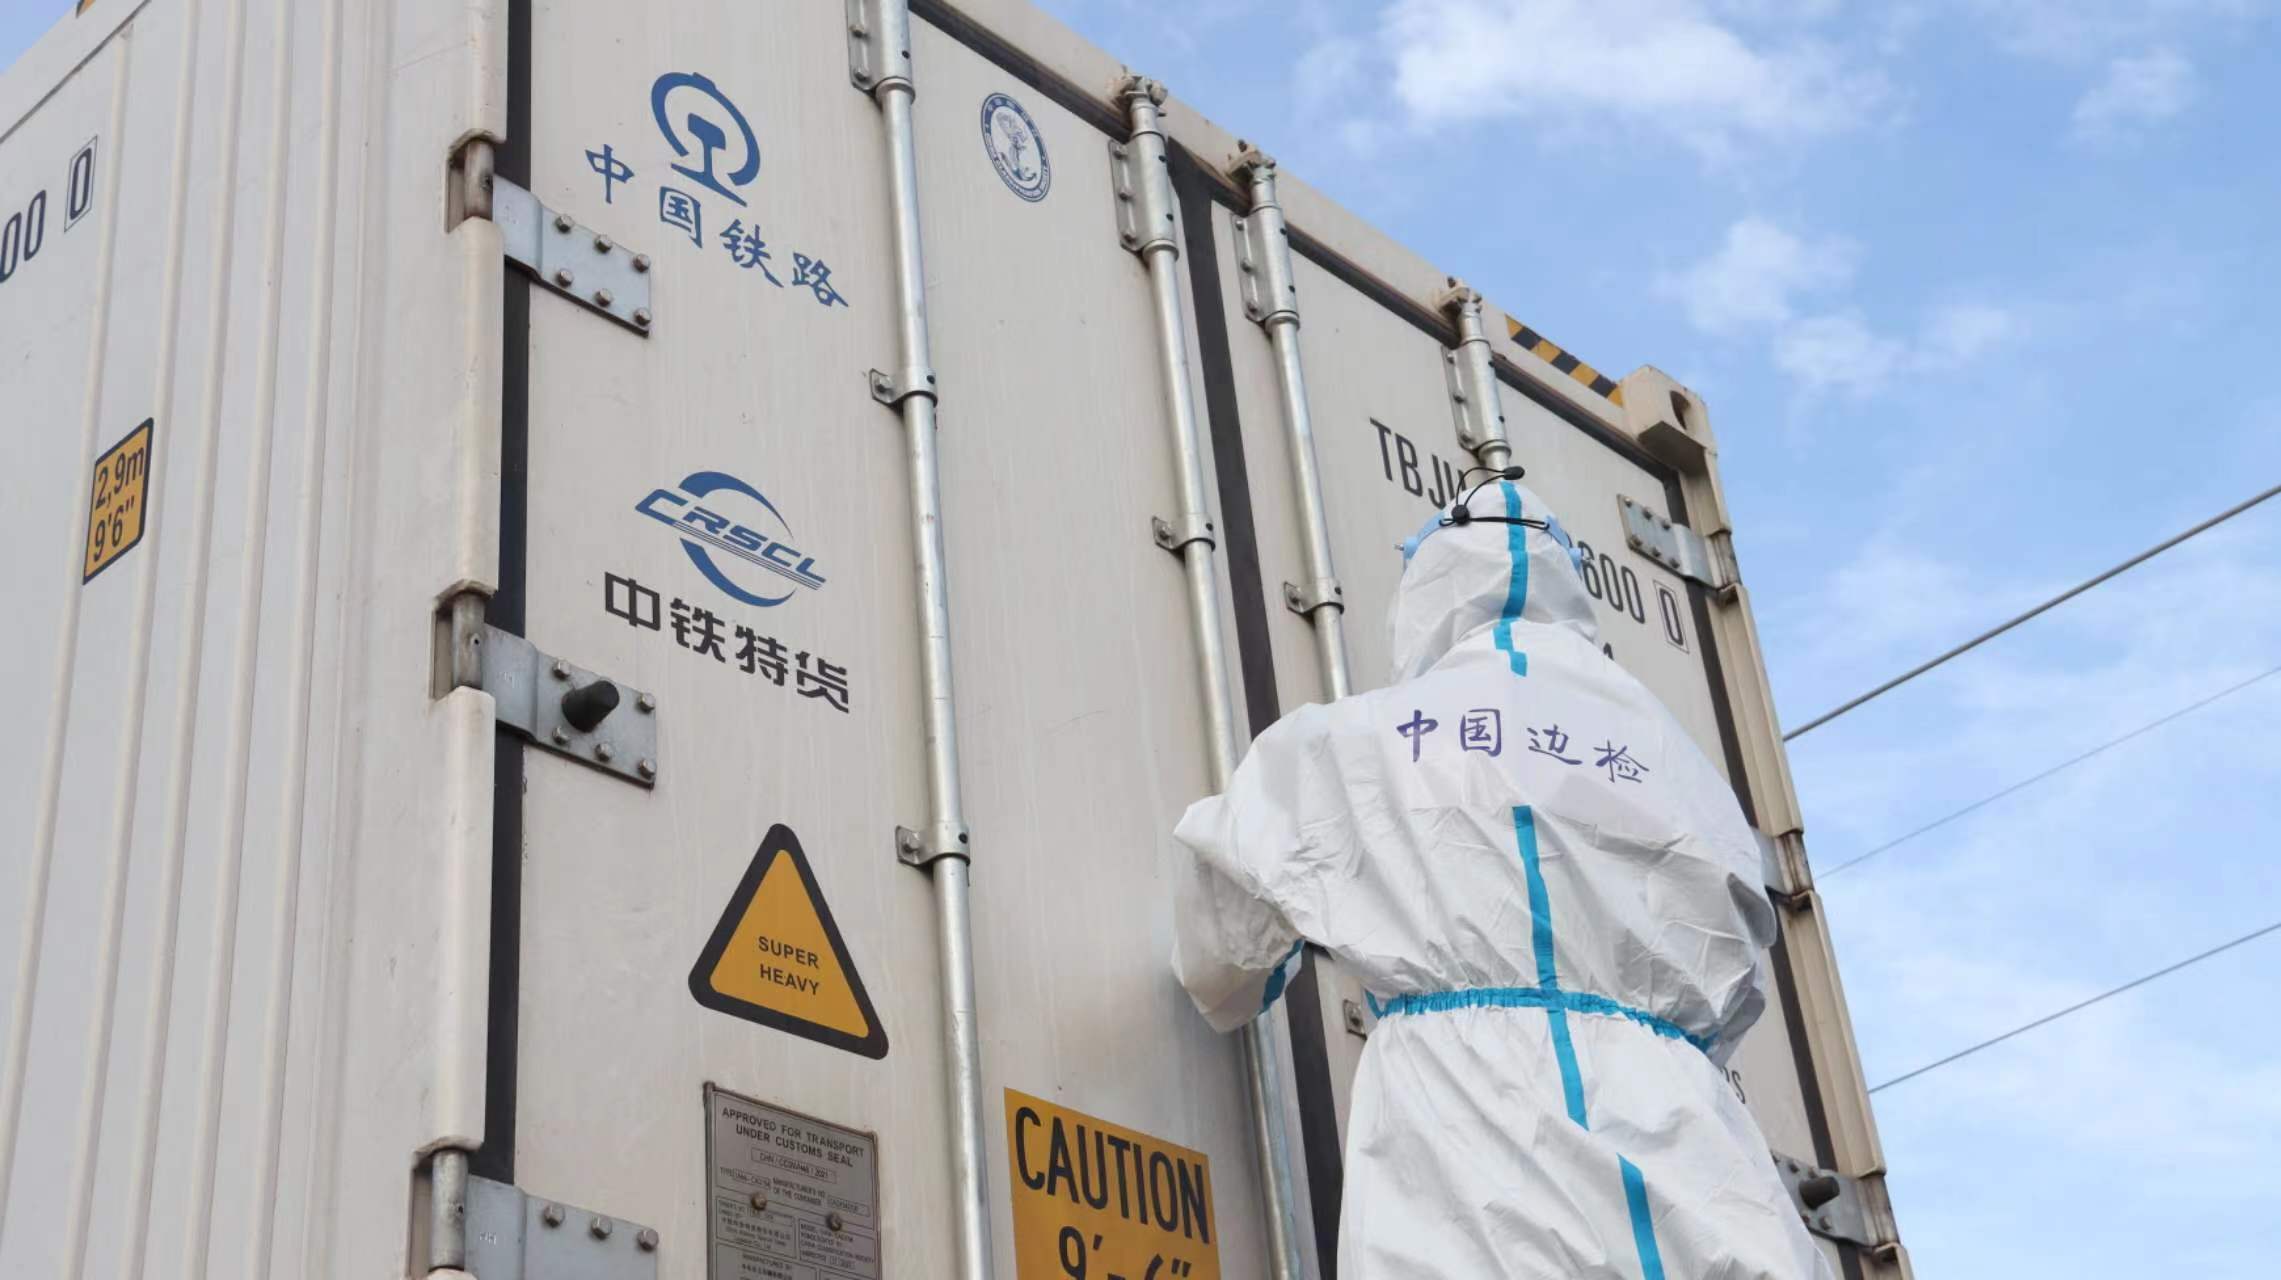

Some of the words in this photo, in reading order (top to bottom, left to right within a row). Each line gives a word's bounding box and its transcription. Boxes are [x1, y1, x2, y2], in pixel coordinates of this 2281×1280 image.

[69, 147, 92, 221] 0
[585, 143, 849, 308] 中国铁路
[635, 488, 827, 585] CRSCL
[1561, 529, 1645, 625] 600
[1660, 587, 1684, 646] 0
[604, 571, 849, 714] 中铁特货
[1396, 708, 1650, 784] 中国边检
[758, 935, 820, 970] SUPER
[759, 963, 820, 996] HEAVY
[722, 1106, 776, 1132] APPROVED
[781, 1124, 801, 1140] FOR
[806, 1131, 864, 1158] TRANSPORT
[735, 1123, 770, 1144] UNDER
[775, 1135, 823, 1159] CUSTOMS
[827, 1150, 853, 1168] SEAL
[1015, 1105, 1210, 1245] CAUTION
